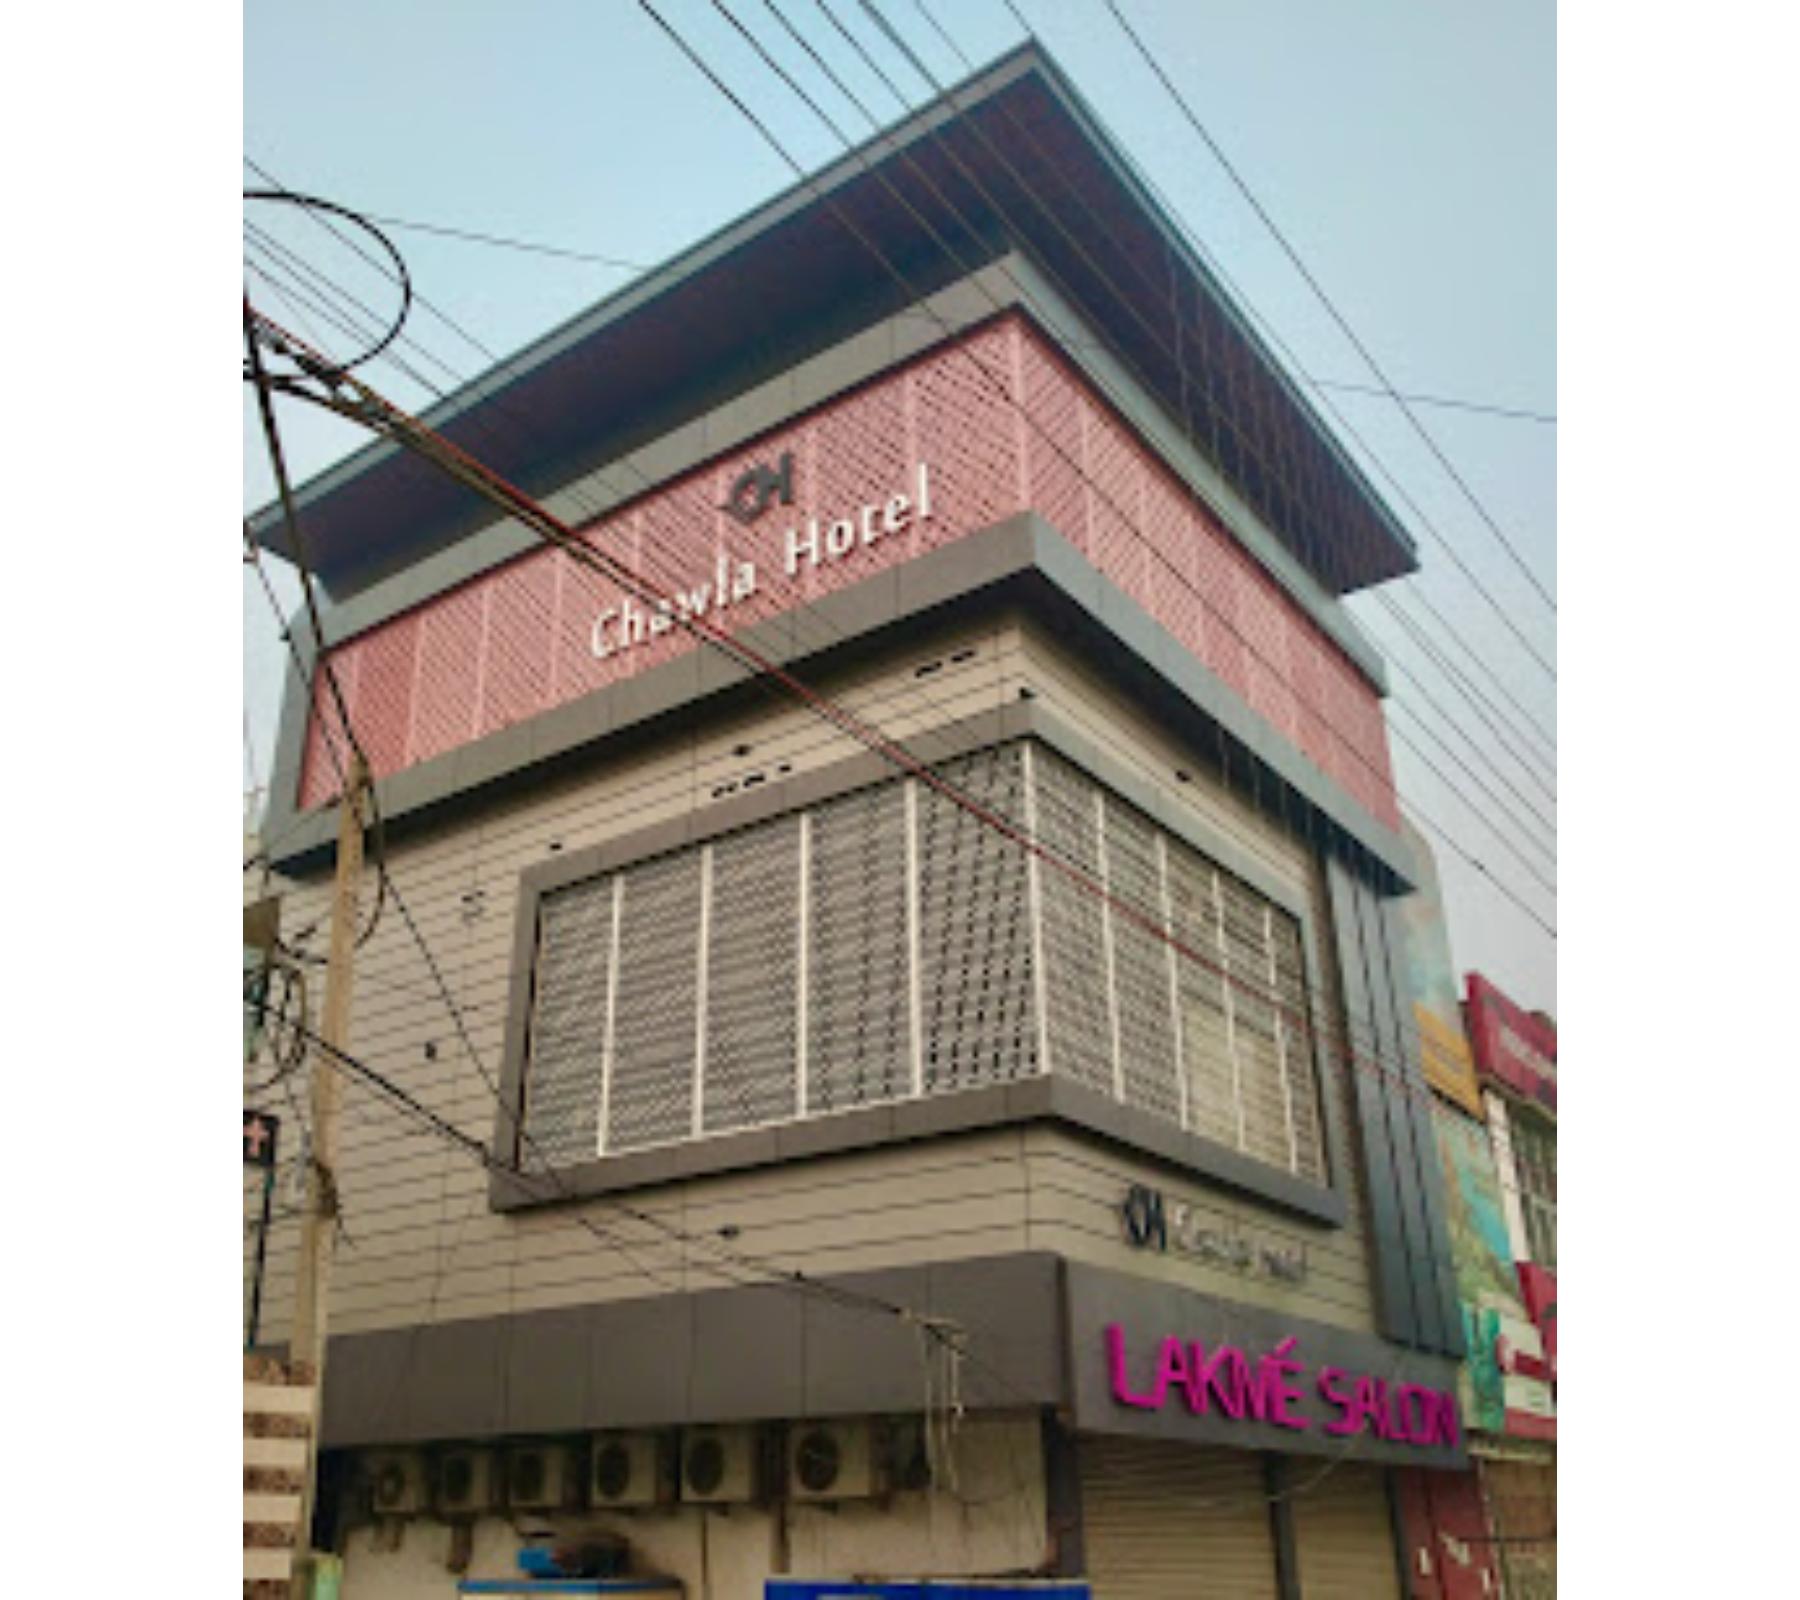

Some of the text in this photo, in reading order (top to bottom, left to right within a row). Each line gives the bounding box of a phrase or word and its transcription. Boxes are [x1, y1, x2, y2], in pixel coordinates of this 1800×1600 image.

[591, 461, 934, 659] Chawla Hotel
[1105, 1322, 1460, 1448] LAKMÉ SALON
